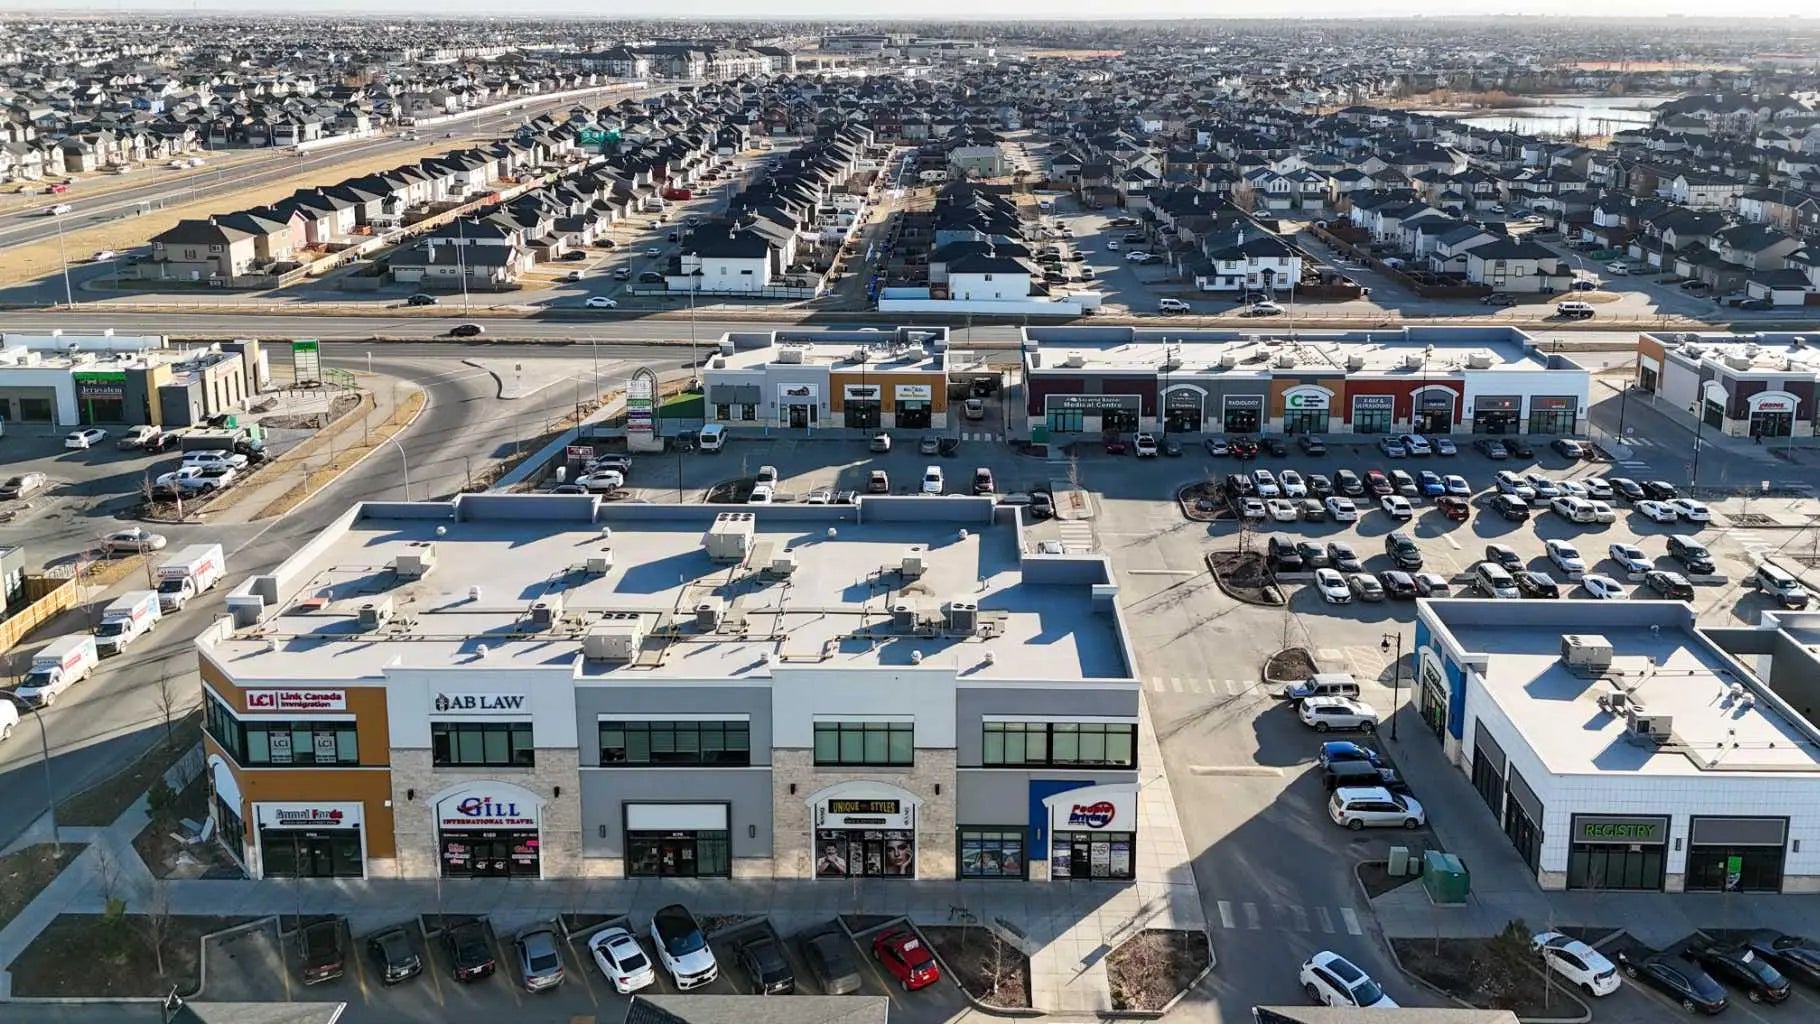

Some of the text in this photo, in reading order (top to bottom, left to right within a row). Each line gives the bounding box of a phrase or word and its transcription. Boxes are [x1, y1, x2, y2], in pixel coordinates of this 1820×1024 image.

[249, 694, 275, 707] LCI
[280, 692, 342, 701] Link Canada
[450, 696, 525, 709] AB LAW
[281, 701, 332, 709] Immigration
[832, 801, 896, 813] UNIQUE STYLES
[1068, 813, 1109, 823] Driving
[1584, 823, 1656, 838] REGISTRY
